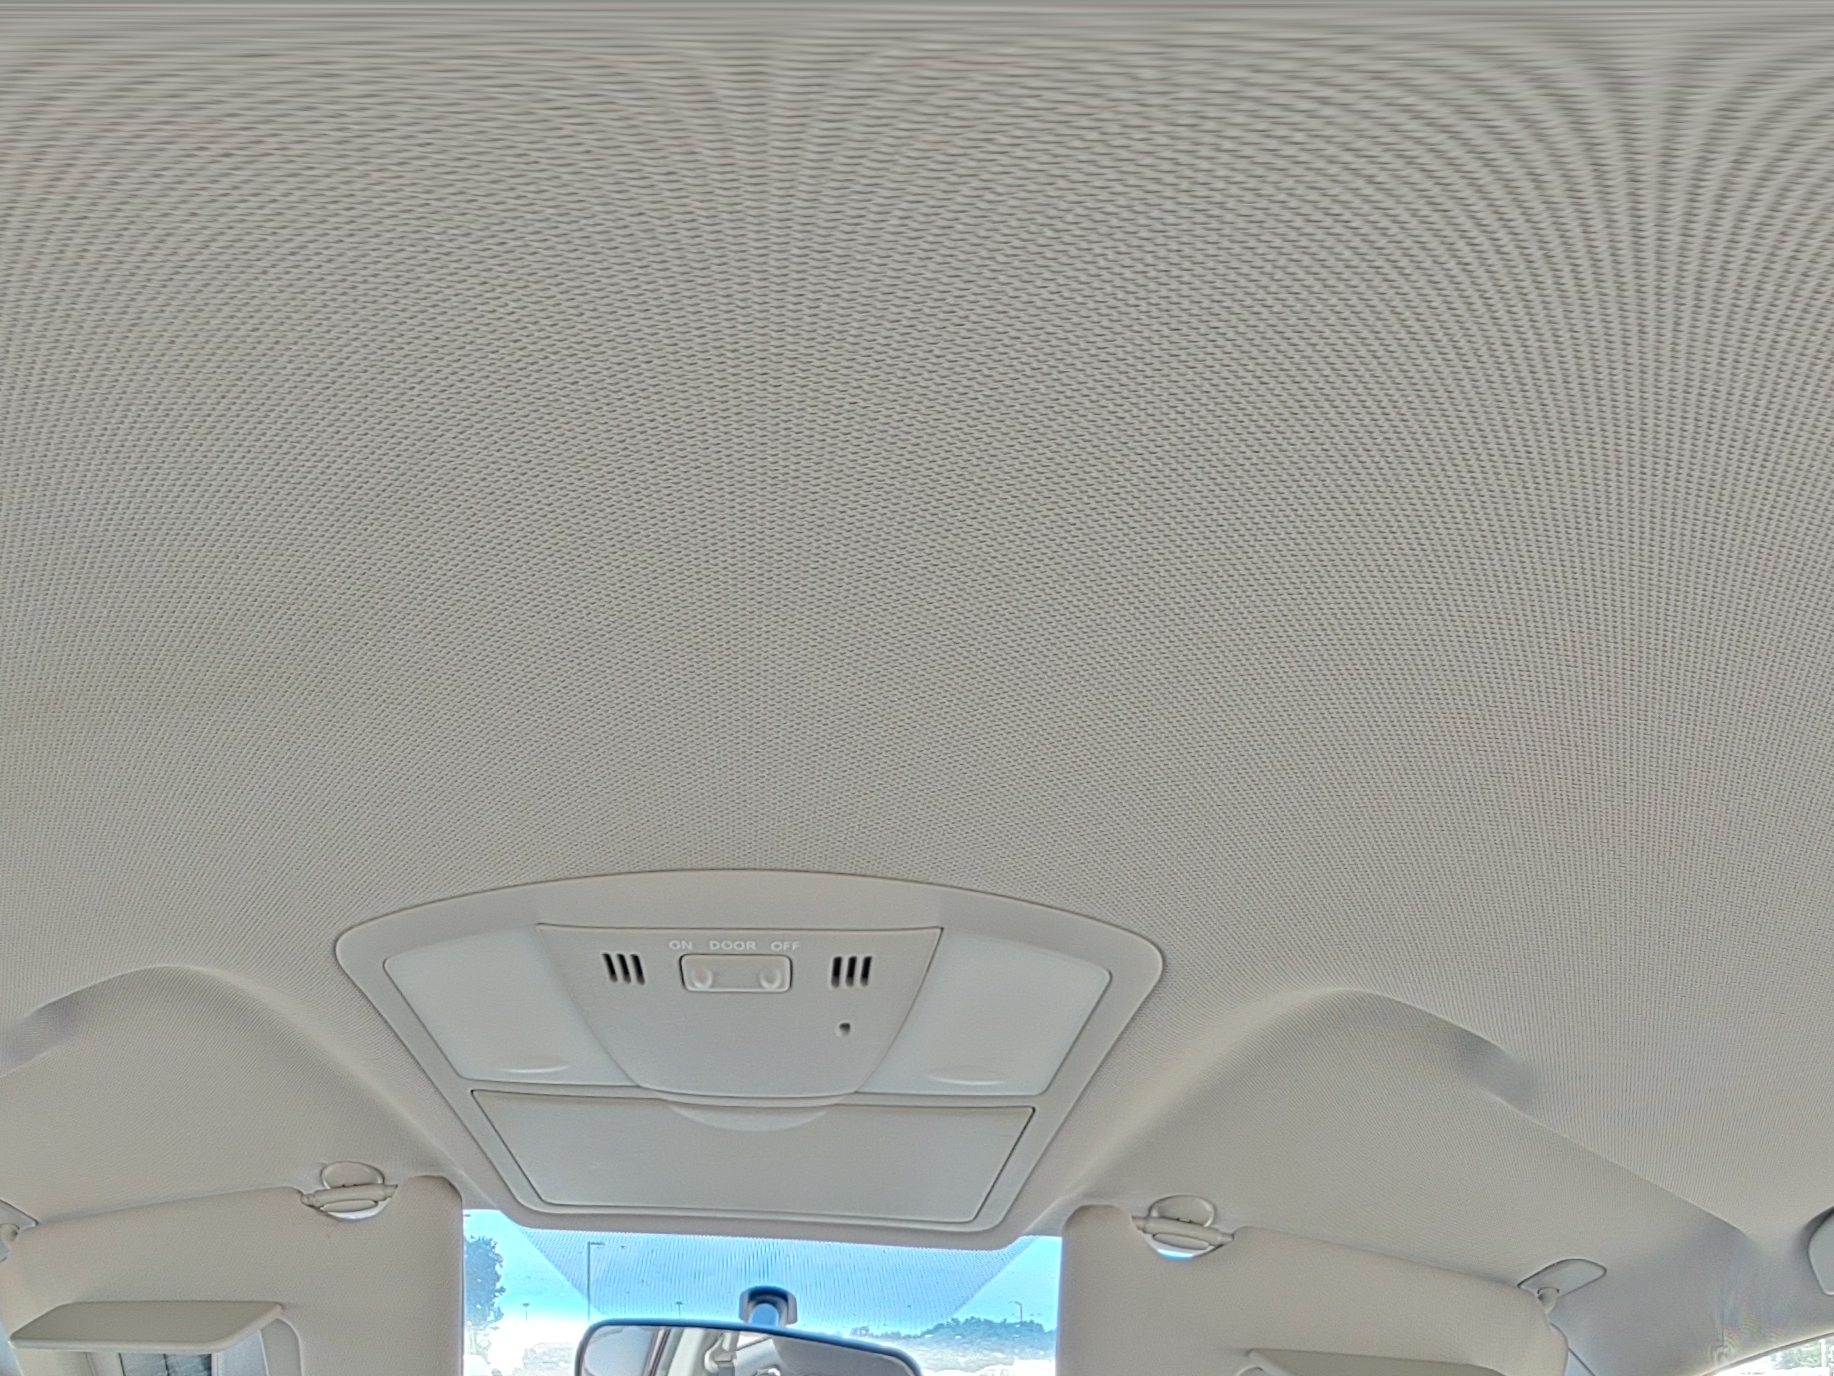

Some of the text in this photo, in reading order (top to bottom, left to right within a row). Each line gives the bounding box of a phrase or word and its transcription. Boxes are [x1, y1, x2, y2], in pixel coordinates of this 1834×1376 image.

[669, 940, 801, 951] ON DOOR OFF
